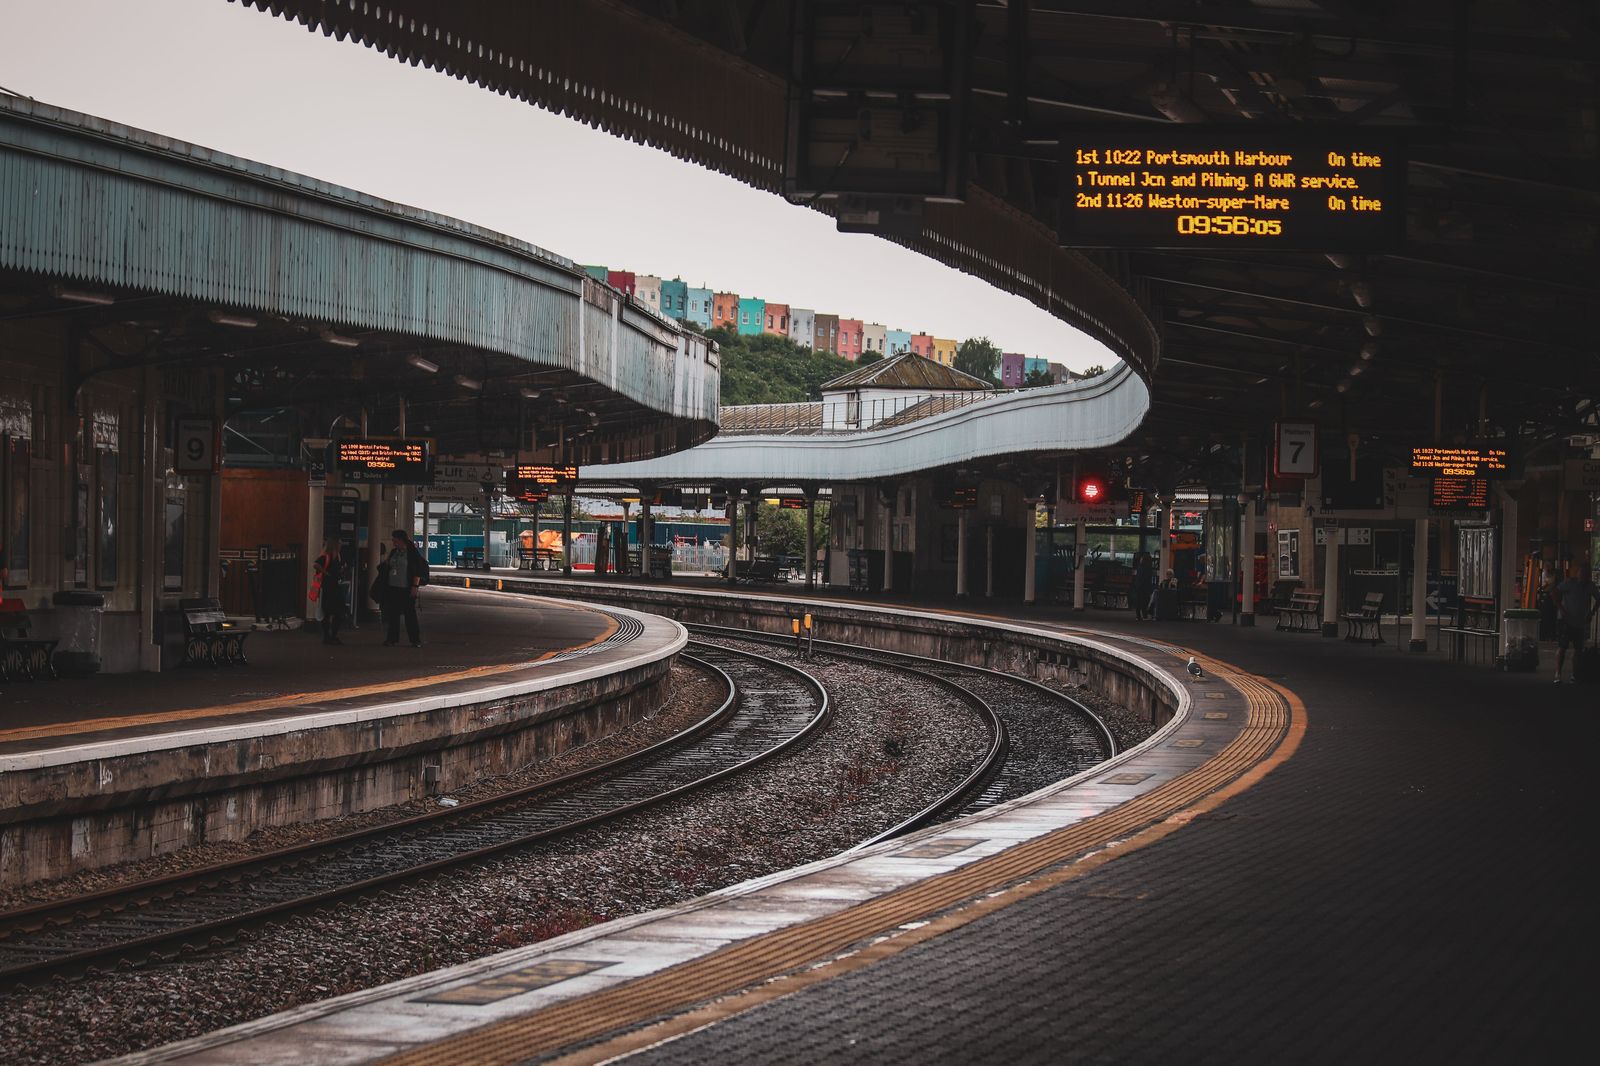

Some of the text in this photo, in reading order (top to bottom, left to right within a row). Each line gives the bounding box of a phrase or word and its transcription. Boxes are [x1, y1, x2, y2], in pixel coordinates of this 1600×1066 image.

[1076, 149, 1381, 168] 1st 10:22 Portsmouth Harbour On time
[1087, 170, 1136, 187] Tunnel
[1141, 171, 1166, 187] Jcn
[1170, 172, 1197, 187] and
[1200, 172, 1249, 191] Pilning.
[1253, 172, 1264, 188] A
[1268, 173, 1296, 189] GWR
[1300, 174, 1359, 189] service.
[1076, 192, 1381, 212] 2nd 11:26 Weston-super-Mare On time
[1177, 214, 1281, 236] 09:56:05
[187, 438, 204, 461] 9
[1289, 441, 1306, 464] 7
[445, 466, 463, 478] Lift
